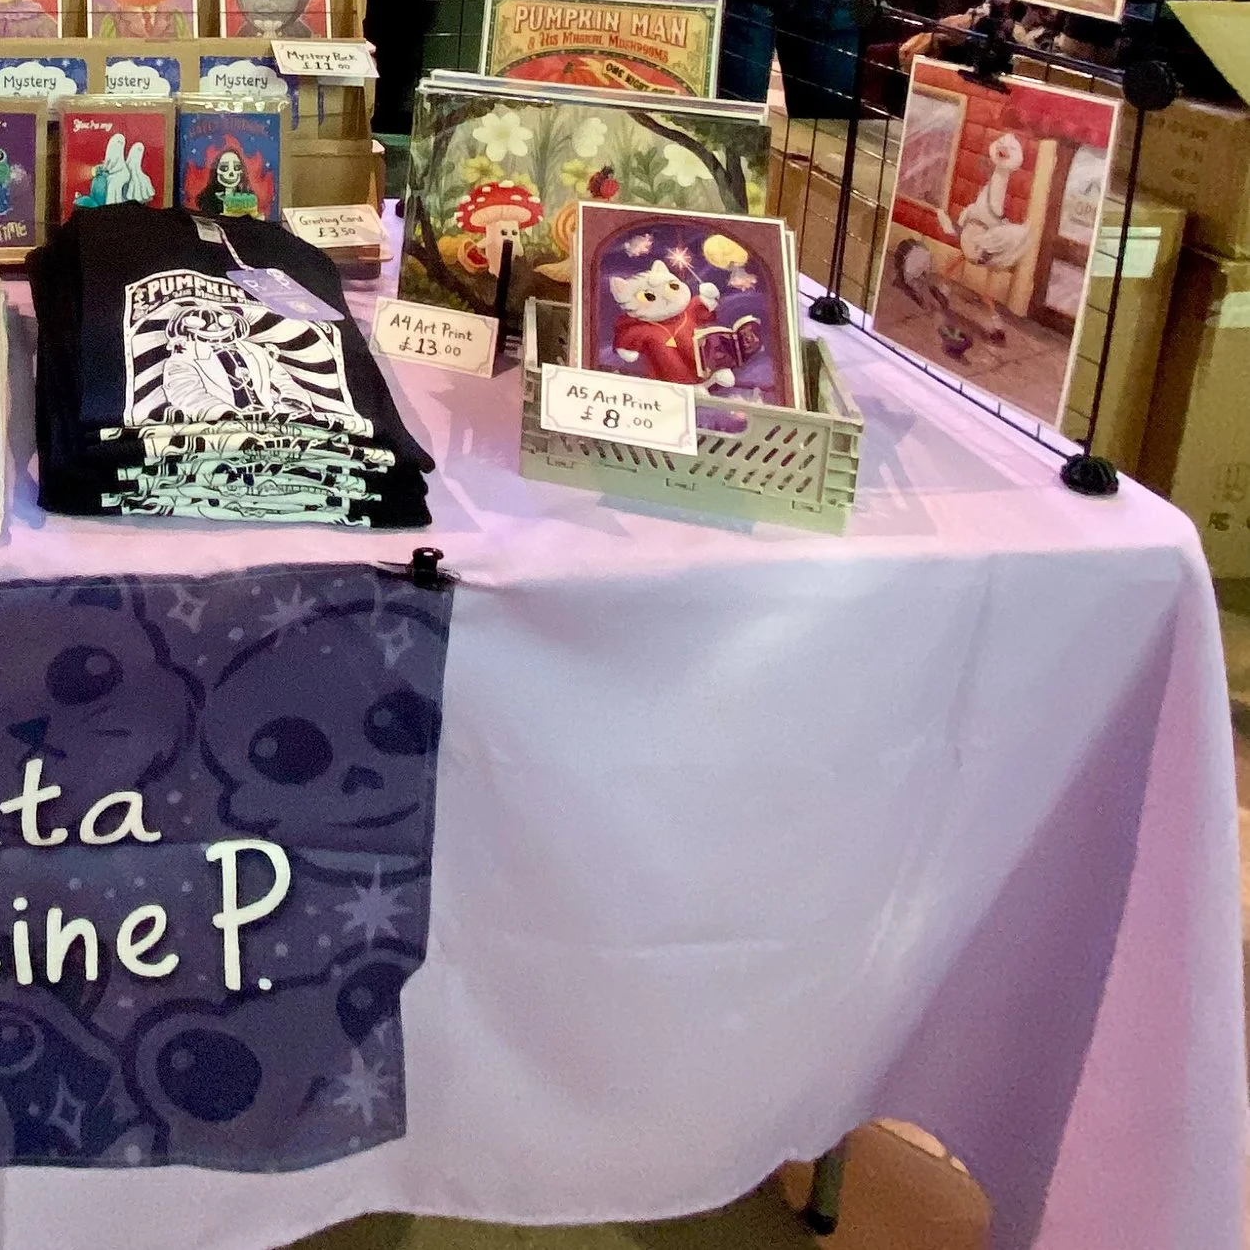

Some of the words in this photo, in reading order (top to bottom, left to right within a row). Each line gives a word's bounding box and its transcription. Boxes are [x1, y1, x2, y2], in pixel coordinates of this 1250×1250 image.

[513, 4, 621, 33] PUMPKIN
[631, 13, 689, 48] MAN
[286, 50, 330, 63] Mystery
[3, 75, 57, 90] Mystery
[215, 74, 268, 89] Mystery
[340, 214, 364, 222] Card
[147, 274, 247, 303] PUMPKIN
[390, 313, 412, 330] A4
[414, 318, 436, 334] Art
[442, 322, 473, 342] Print
[566, 384, 589, 400] A5
[592, 390, 618, 405] Art
[622, 393, 662, 412] Print
[204, 837, 293, 992] P.
